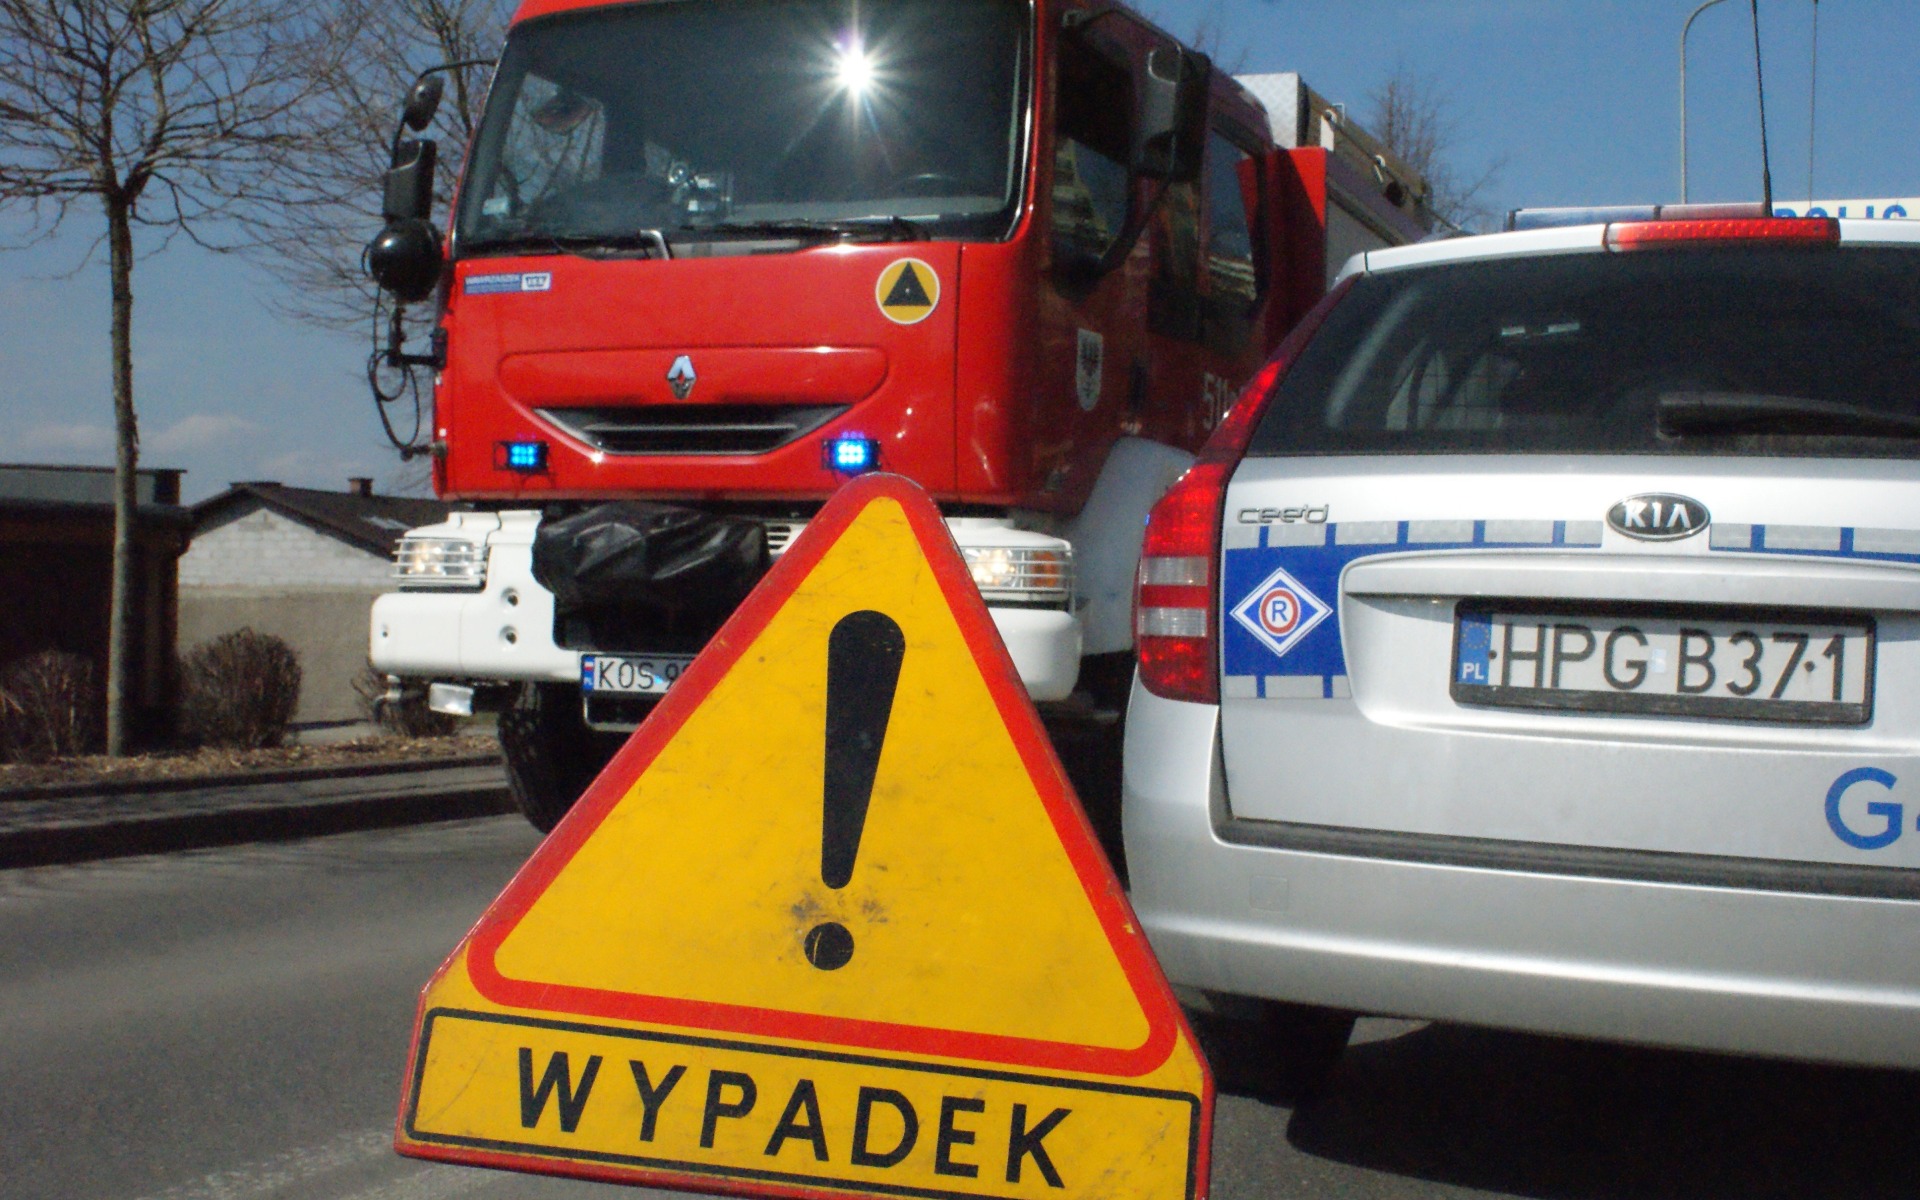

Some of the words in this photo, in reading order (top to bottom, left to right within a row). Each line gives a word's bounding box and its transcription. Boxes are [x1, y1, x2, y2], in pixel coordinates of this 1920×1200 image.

[1622, 500, 1692, 529] KIA
[1272, 600, 1288, 622] R
[599, 661, 654, 689] KOS
[664, 663, 689, 689] 9
[1462, 662, 1484, 680] PL
[1503, 623, 1649, 690] HPG
[1677, 628, 1846, 701] B371
[1824, 766, 1920, 850] G
[517, 1046, 1072, 1190] WYPADEK
